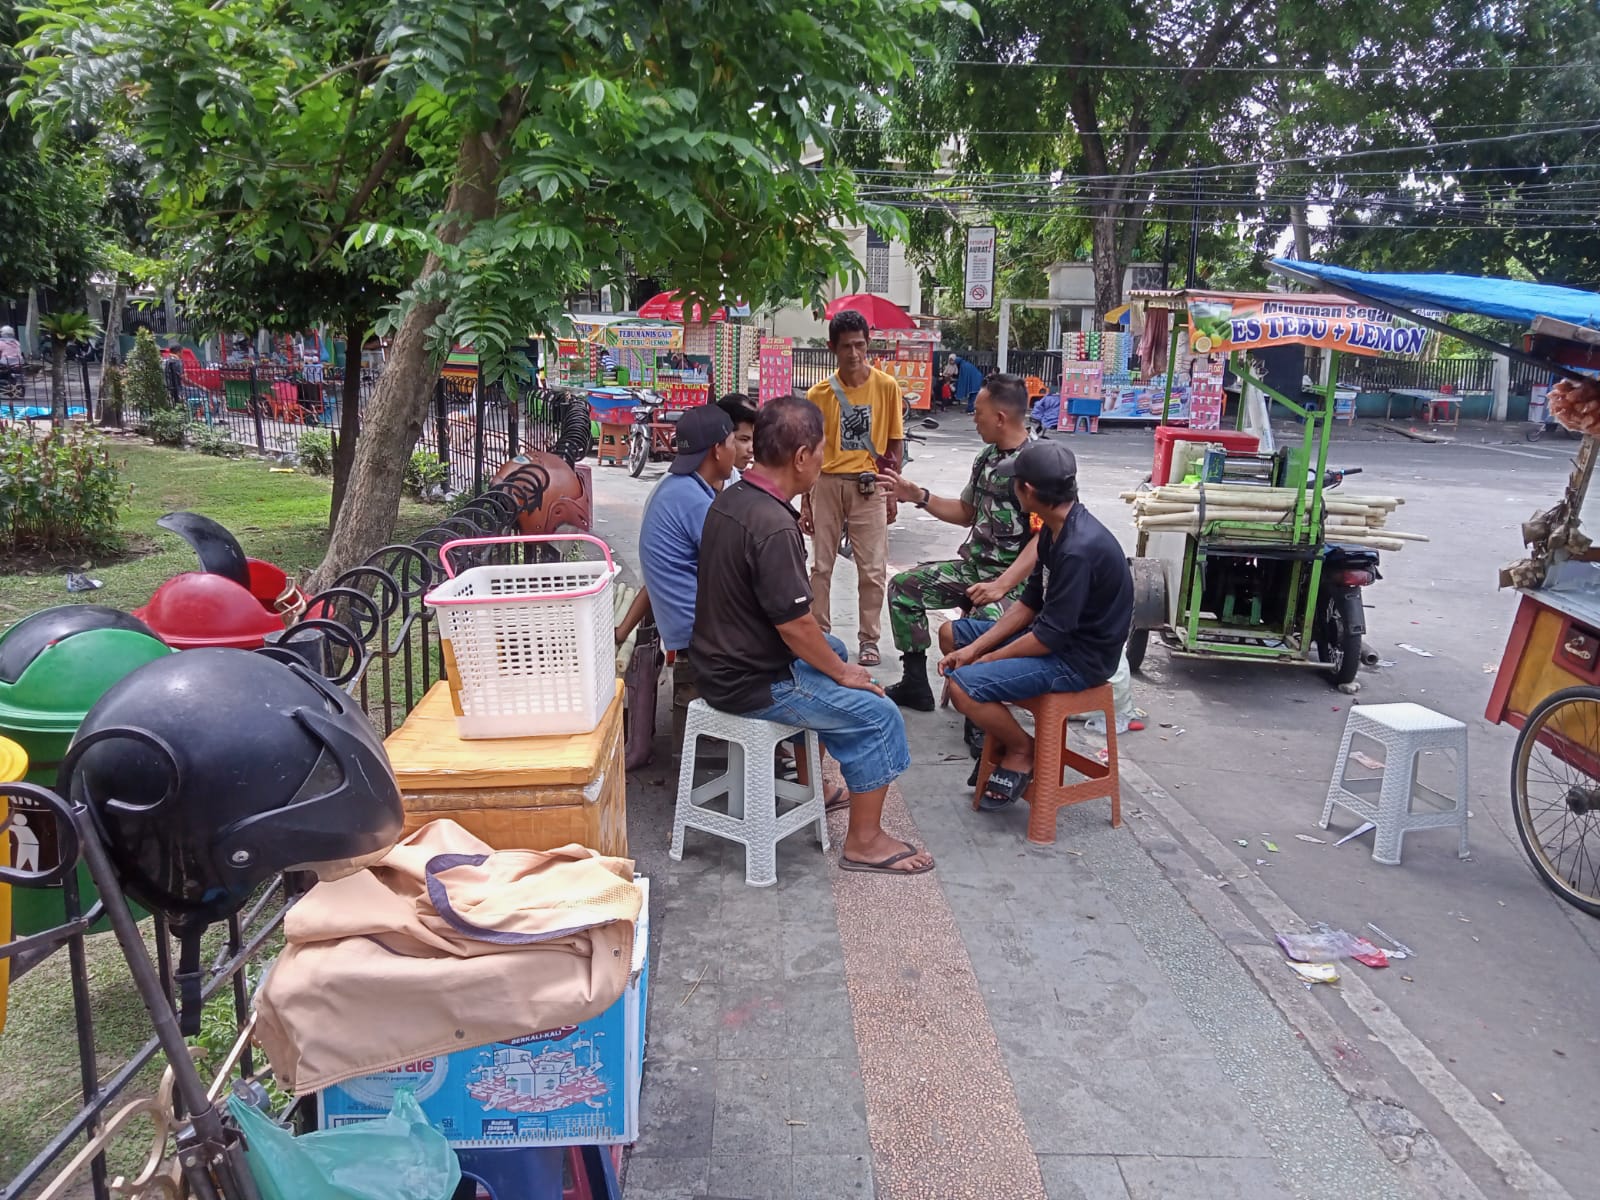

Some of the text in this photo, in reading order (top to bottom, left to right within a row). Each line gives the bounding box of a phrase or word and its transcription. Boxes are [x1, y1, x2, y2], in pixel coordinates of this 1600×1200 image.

[1263, 302, 1341, 318] Minuman
[1231, 316, 1427, 355] ES TEBU + LEMON
